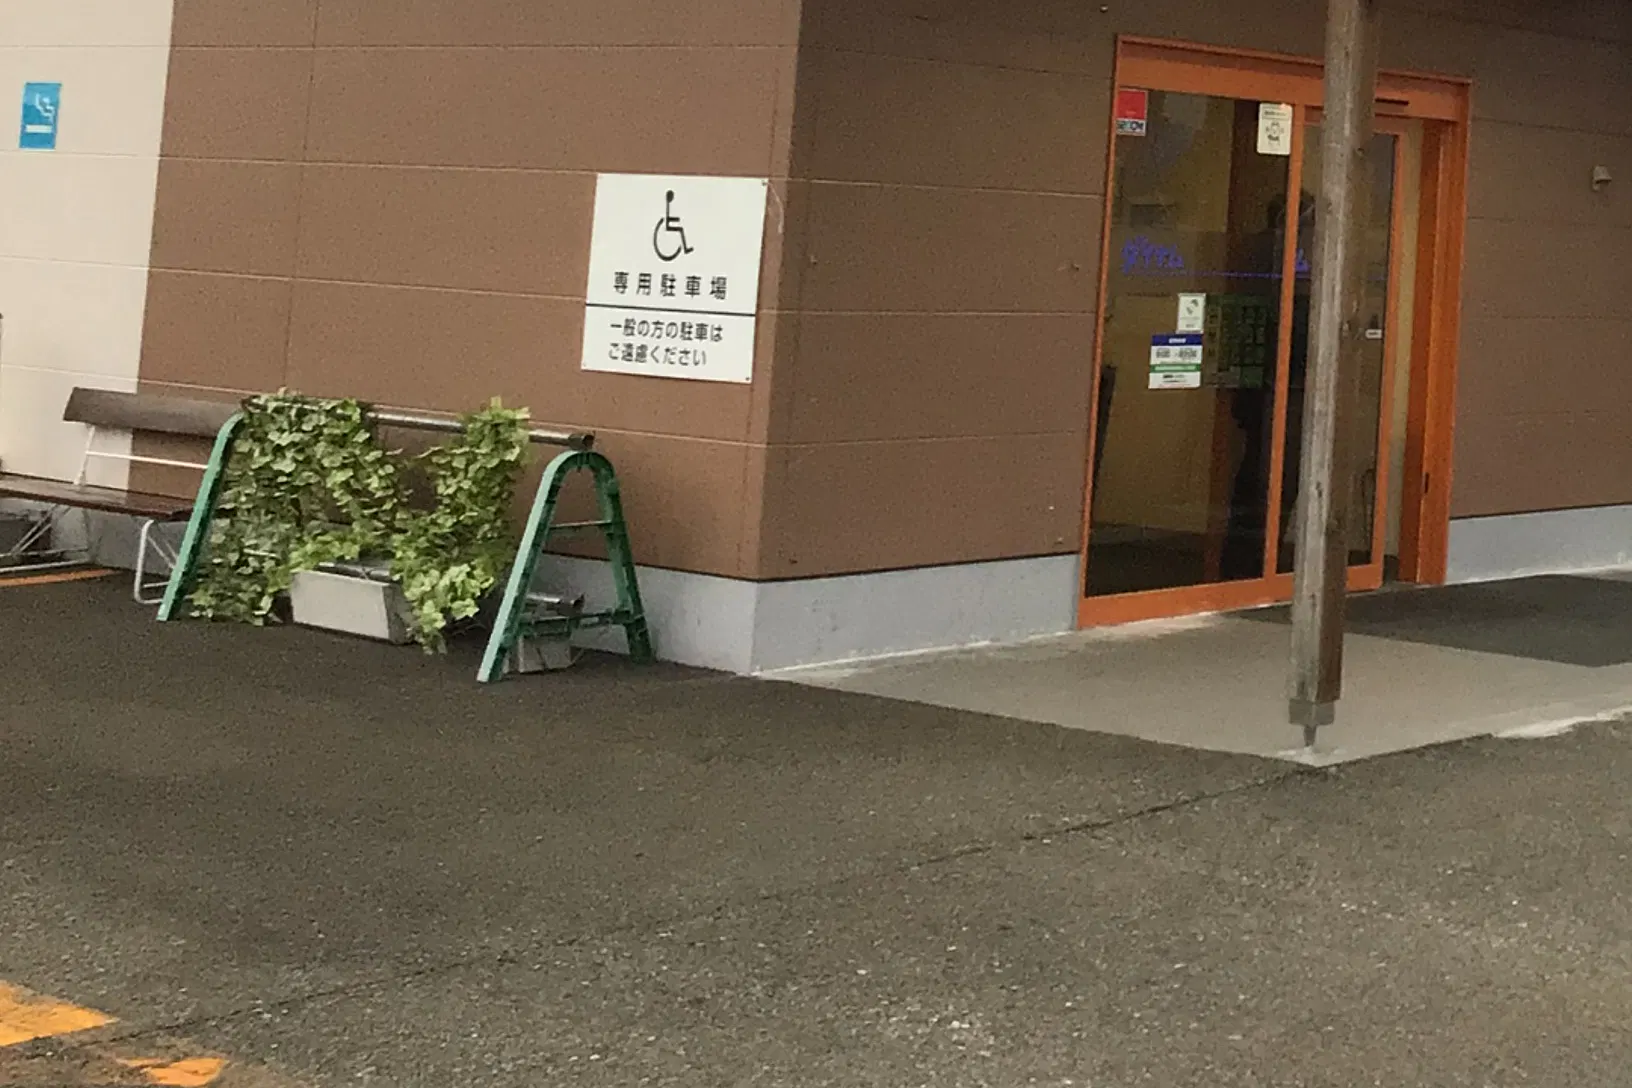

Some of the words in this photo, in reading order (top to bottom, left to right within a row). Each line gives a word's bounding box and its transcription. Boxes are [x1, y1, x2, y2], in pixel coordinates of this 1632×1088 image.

[614, 271, 728, 300] 専用駐車場
[610, 317, 723, 342] 一般の方の駐車は
[608, 342, 707, 366] ご遠慮ください
